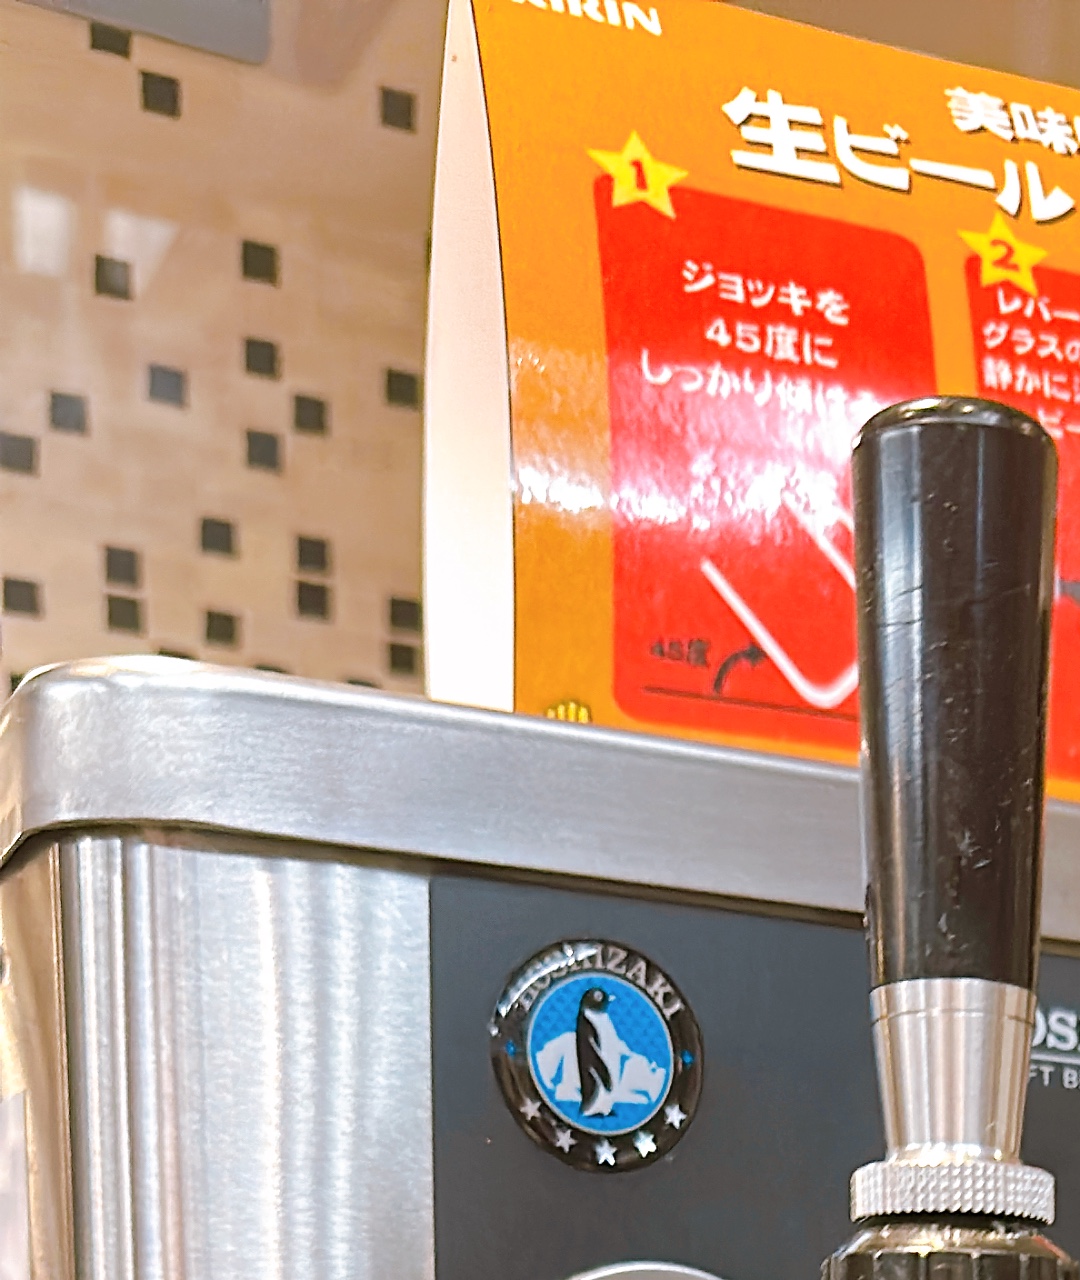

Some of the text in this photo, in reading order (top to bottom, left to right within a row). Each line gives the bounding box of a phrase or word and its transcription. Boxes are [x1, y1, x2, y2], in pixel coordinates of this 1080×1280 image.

[631, 158, 650, 190] 1
[993, 239, 1021, 268] 2
[682, 259, 849, 326] ジョッキを
[705, 317, 838, 369] 45度に
